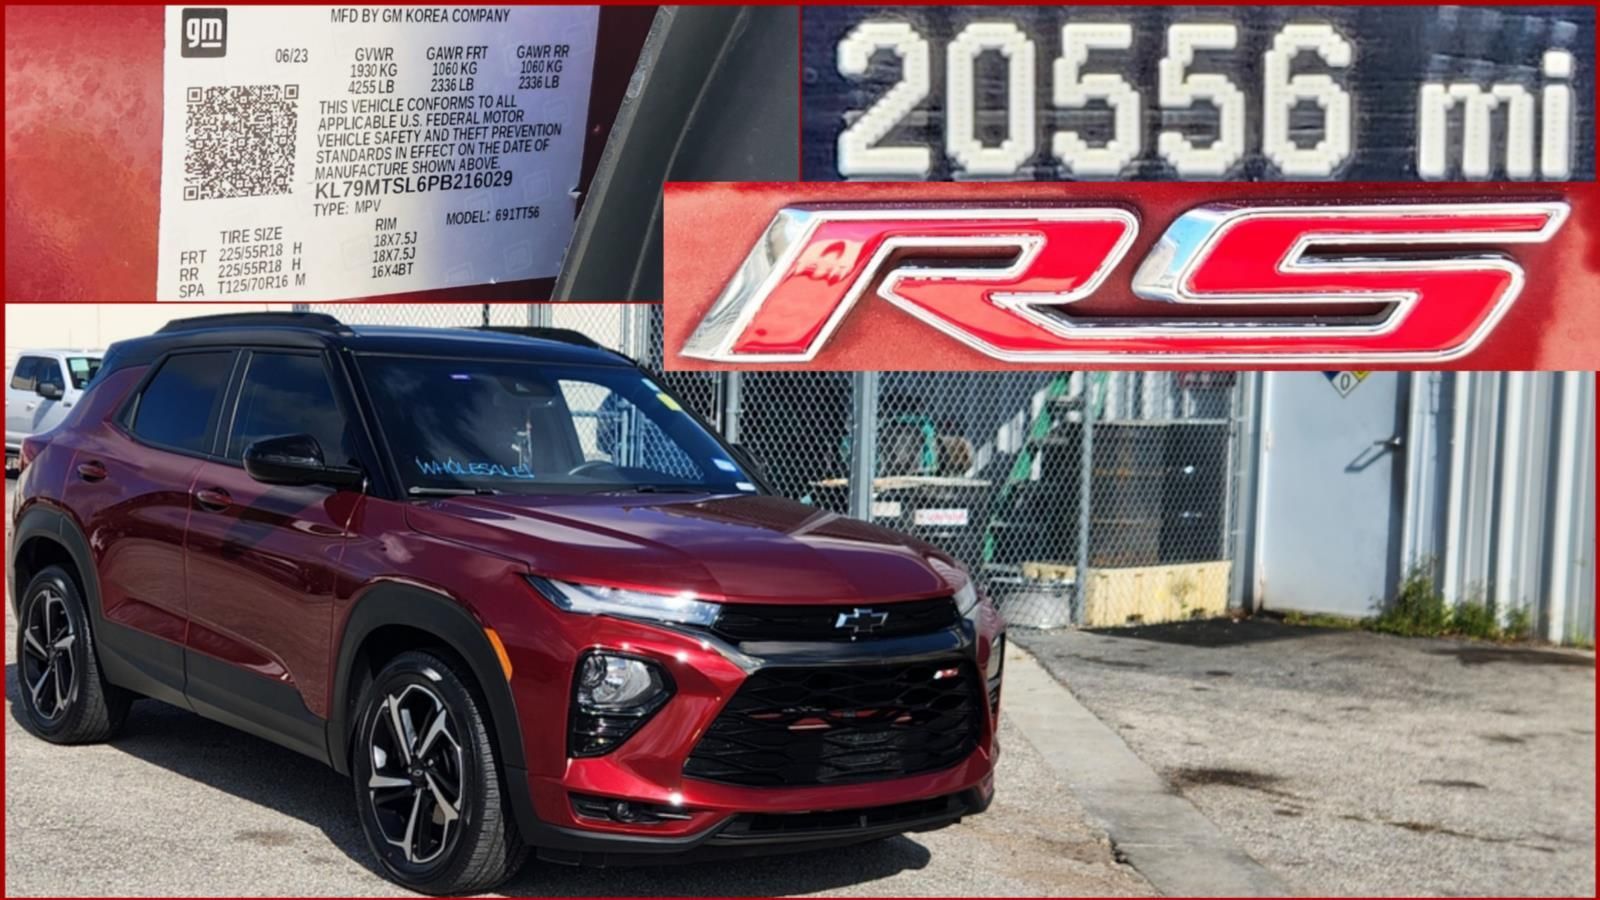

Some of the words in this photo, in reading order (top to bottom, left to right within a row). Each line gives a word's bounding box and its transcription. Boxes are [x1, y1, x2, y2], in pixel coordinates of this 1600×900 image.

[331, 8, 358, 23] MFD
[362, 8, 380, 23] BY
[382, 8, 402, 23] GM
[406, 8, 449, 23] KOREA
[452, 8, 511, 23] COMPANY
[186, 18, 223, 48] gm
[275, 48, 309, 63] 06/23
[354, 47, 394, 62] GVWR
[426, 46, 463, 60] GAWR
[466, 45, 488, 60] FRT
[516, 45, 550, 59] GAWR
[553, 44, 570, 58] RR
[350, 63, 377, 78] 1930
[379, 63, 398, 77] KG
[432, 62, 458, 76] 1060
[460, 61, 478, 75] KG
[520, 60, 544, 74] 1060
[546, 59, 563, 73] KG
[347, 80, 376, 95] 4255
[378, 80, 395, 94] LB
[430, 78, 456, 92] 2336
[459, 77, 474, 92] LB
[518, 76, 542, 90] 2336
[545, 75, 560, 89] LB
[320, 100, 348, 115] THIS
[352, 98, 404, 114] VEHICLE
[407, 96, 475, 112] CONFORMS
[478, 95, 493, 109] TO
[496, 94, 517, 108] ALL
[837, 22, 1354, 176] 20556
[1417, 50, 1573, 179] mi
[318, 114, 397, 131] APPLICABLE
[400, 113, 422, 128] U.S.
[426, 111, 480, 127] FEDERAL
[483, 109, 524, 124] MOTOR
[317, 132, 371, 147] VEHICLE
[374, 129, 421, 145] SAFETY
[424, 128, 449, 142] AND
[453, 126, 489, 141] THEFT
[491, 123, 562, 139] PREVENTION
[316, 147, 392, 164] STANDARDS
[395, 146, 407, 160] IN
[410, 143, 455, 159] EFFECT
[458, 143, 475, 156] ON
[478, 141, 500, 155] THE
[503, 139, 532, 154] DATE
[534, 138, 550, 152] OF
[315, 161, 409, 180] MANUFACTURE
[412, 159, 455, 175] SHOWN
[458, 156, 500, 171] ABOVE.
[315, 170, 513, 200] KL79MTSL6PB216029
[313, 202, 349, 217] TYPE:
[355, 199, 382, 214] MPV
[446, 209, 491, 225] MODEL:
[495, 206, 540, 222] 691TT56
[375, 217, 397, 231] RIM
[220, 228, 250, 244] TIRE
[254, 226, 283, 242] SIZE
[373, 231, 418, 248] 18X7.5J
[180, 250, 207, 265] FRT
[219, 244, 283, 262] 225/55R18
[293, 242, 302, 255] H
[372, 247, 416, 263] 18X7.5J
[179, 267, 199, 282] RR
[218, 260, 282, 278] 225/55R18
[292, 258, 301, 271] H
[371, 262, 414, 279] 16X4BT
[179, 283, 205, 299] SPA
[217, 274, 288, 295] T125/70R16
[295, 273, 306, 287] M
[681, 202, 1571, 363] RS
[1340, 373, 1351, 391] 0
